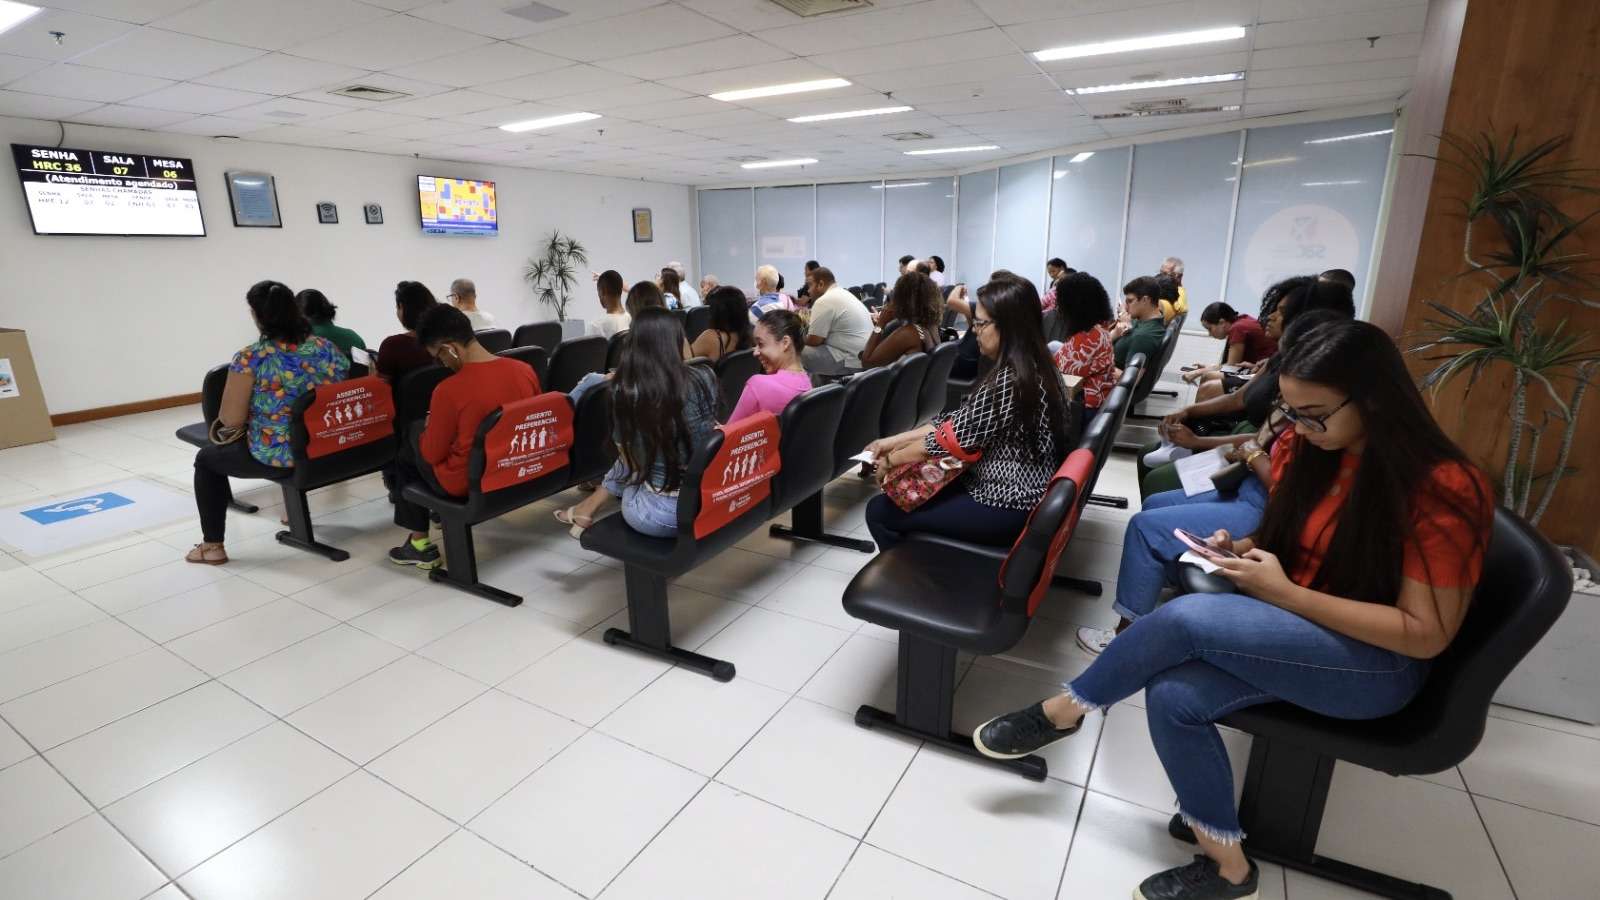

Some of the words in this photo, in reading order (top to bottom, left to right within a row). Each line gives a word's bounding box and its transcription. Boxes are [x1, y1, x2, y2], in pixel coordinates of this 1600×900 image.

[31, 148, 79, 161] SENHA
[32, 160, 63, 171] HRC
[64, 162, 82, 172] 36
[102, 155, 135, 166] SALA
[152, 159, 184, 169] MESA
[113, 166, 129, 175] 07
[163, 169, 178, 179] 06
[45, 173, 123, 186] (Atendimento
[125, 180, 178, 190] agendado)
[336, 387, 365, 399] ASSENTO
[525, 410, 552, 420] ASSENTO
[741, 429, 765, 443] ASSENTO
